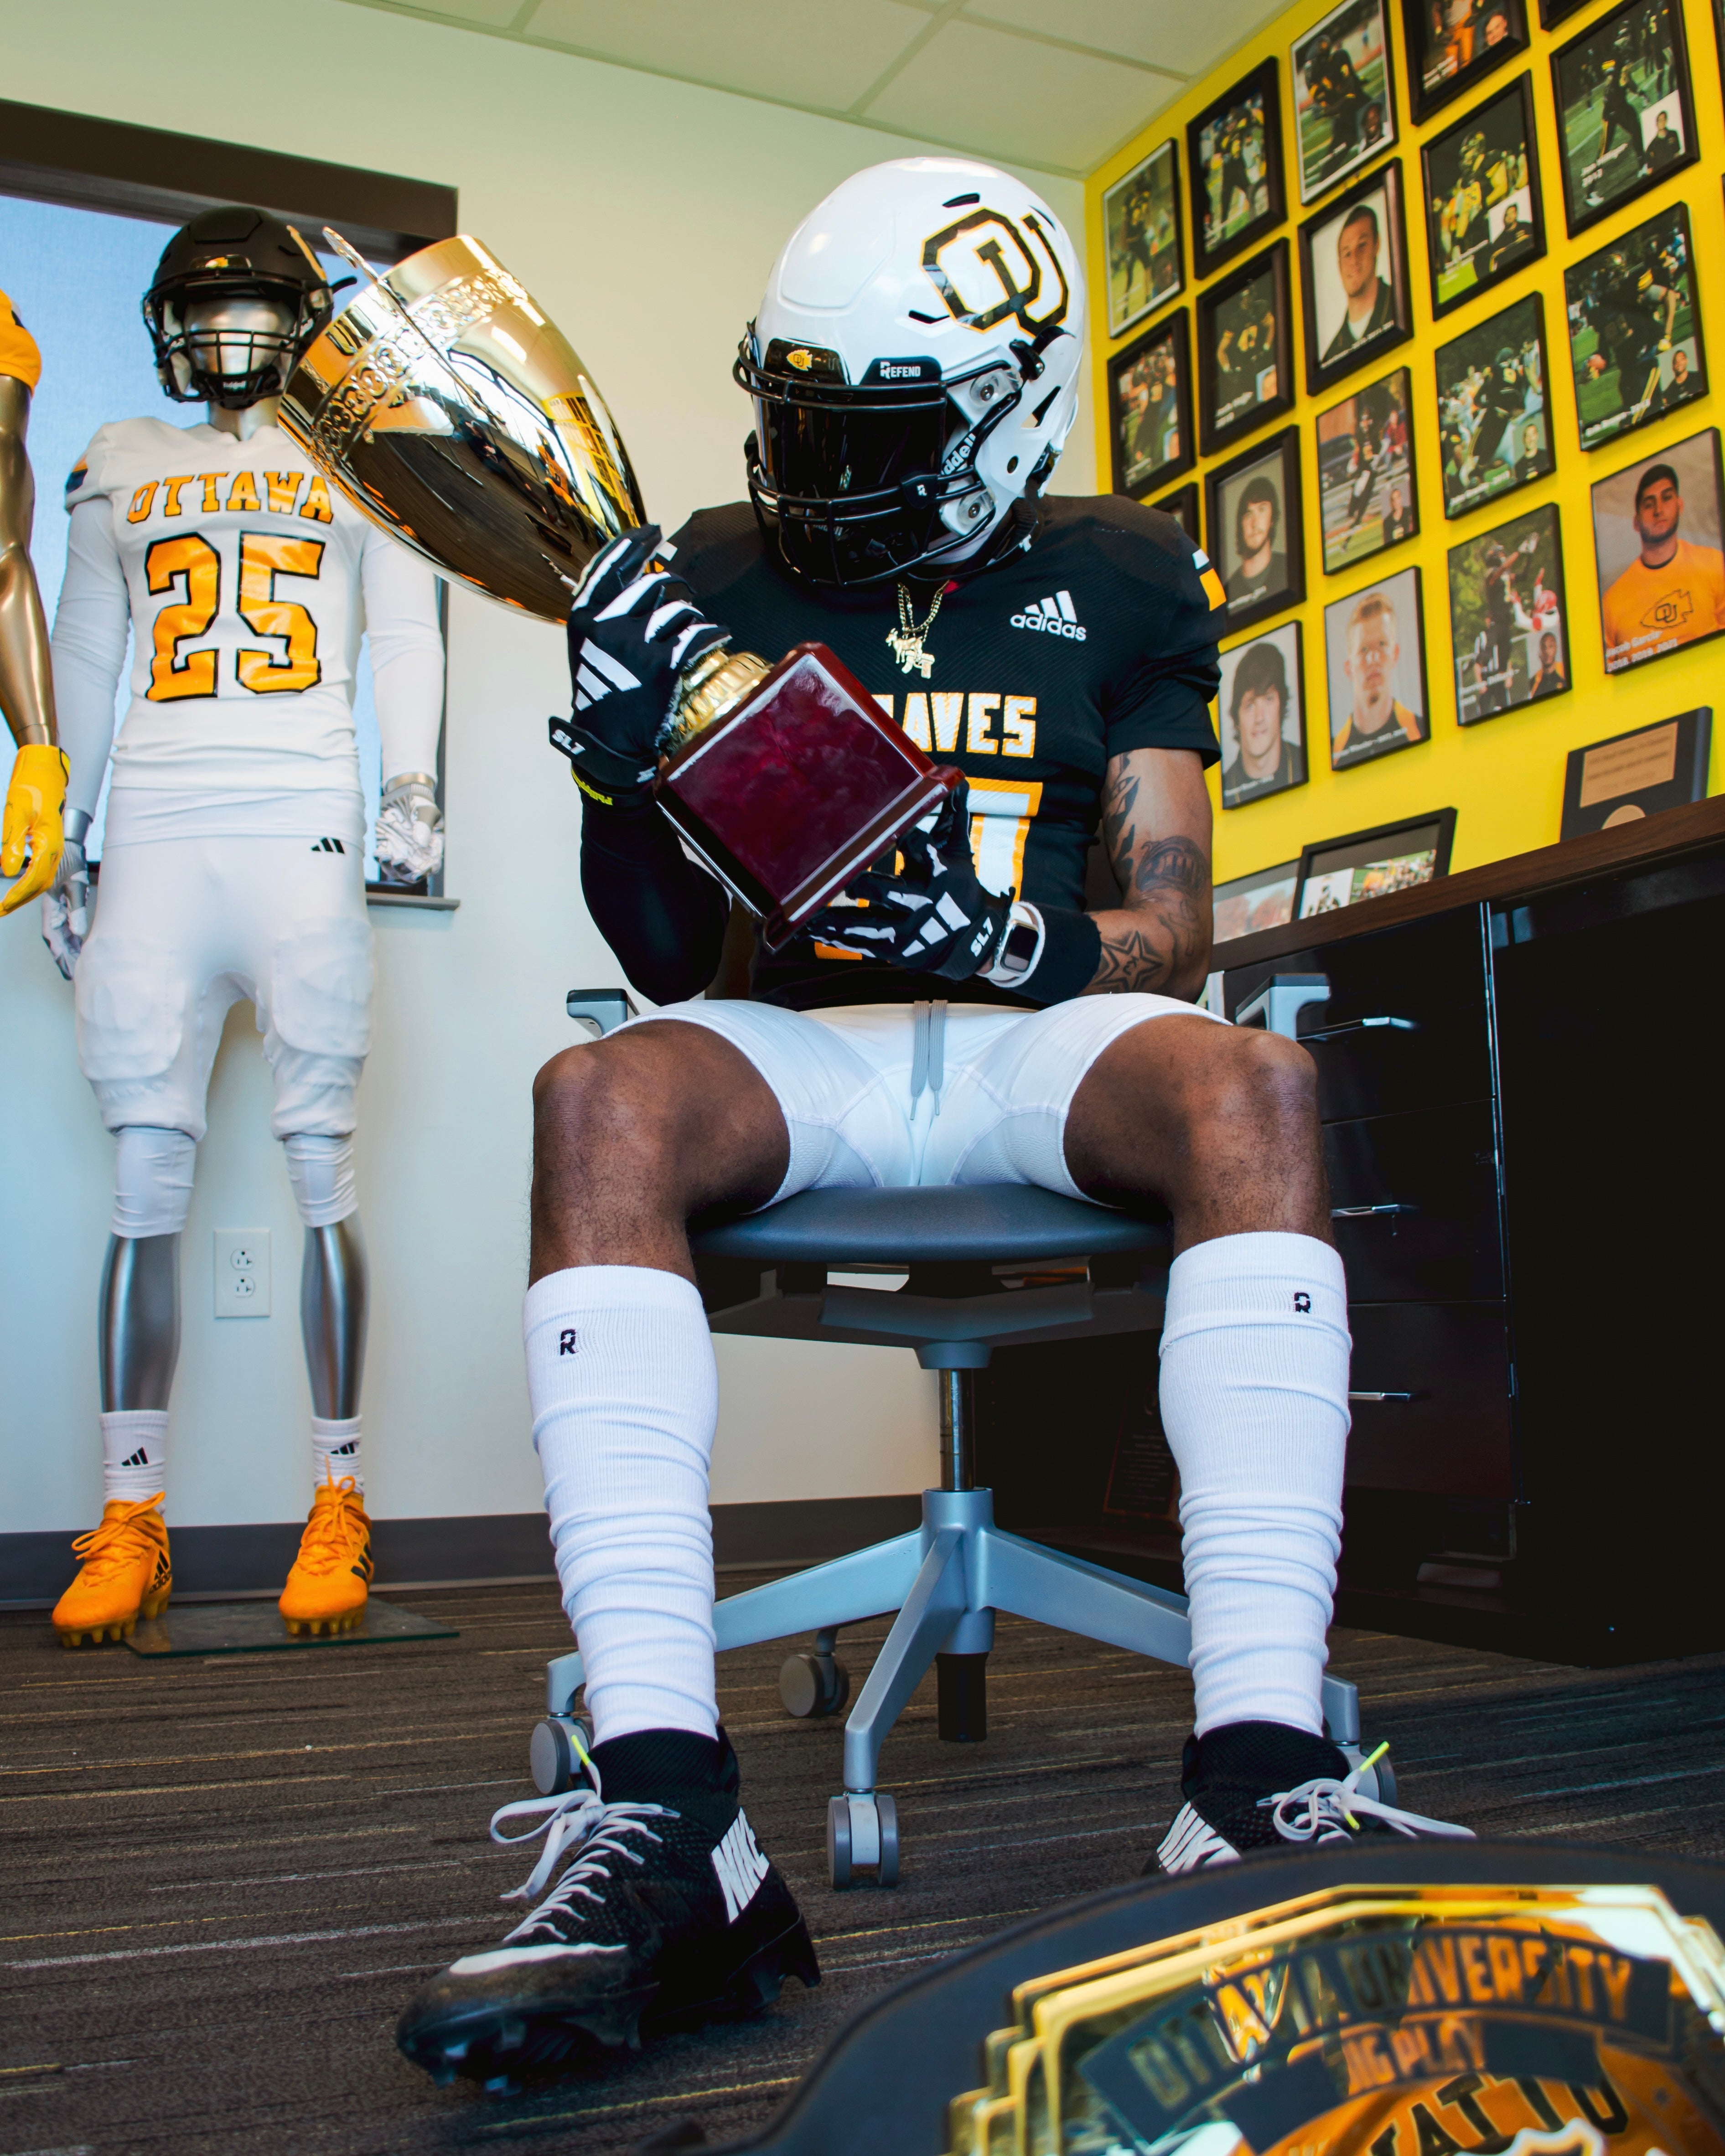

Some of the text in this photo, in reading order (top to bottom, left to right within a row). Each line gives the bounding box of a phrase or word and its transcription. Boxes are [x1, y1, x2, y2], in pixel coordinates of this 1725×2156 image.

[127, 471, 333, 524] OTTAWA
[145, 531, 326, 703] 25
[1010, 613, 1087, 642] adidas
[970, 916, 993, 957] SL7
[1336, 1933, 1632, 2022] UNIVERSITY
